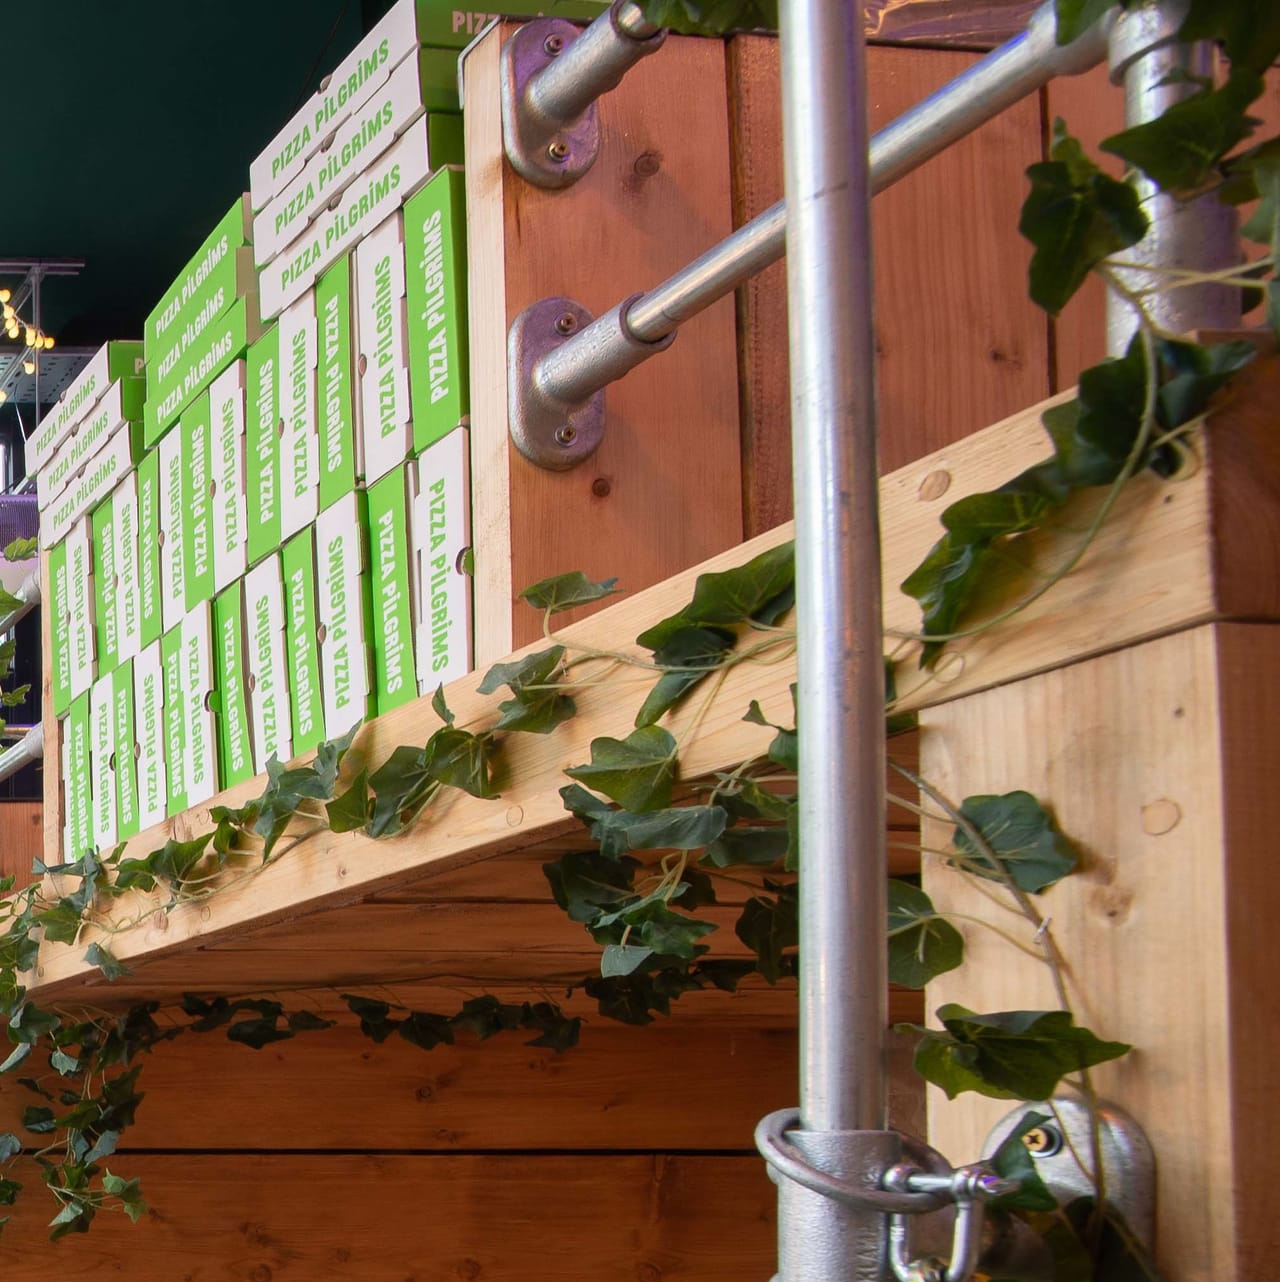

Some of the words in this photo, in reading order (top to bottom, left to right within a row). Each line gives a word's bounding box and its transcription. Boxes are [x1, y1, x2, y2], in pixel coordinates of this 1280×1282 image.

[452, 10, 498, 35] PIZ
[272, 124, 311, 179] PIZZA
[275, 182, 314, 236] PIZZA
[281, 240, 321, 291] PIZZA
[156, 296, 181, 339] PIZZA
[325, 294, 339, 364] PIZZA
[158, 346, 181, 384] PIZZA
[428, 327, 449, 405] PIZZA
[157, 384, 183, 425] PIZZA
[381, 367, 396, 438] PIZZA
[36, 425, 57, 456] PIZZA
[294, 432, 308, 498] PIZZA
[48, 458, 69, 490] PIZZA
[260, 460, 273, 525] PIZZA
[53, 499, 75, 529] PIZZA
[143, 479, 151, 532] PIZZA
[223, 493, 238, 553] PIZZA
[429, 478, 446, 552] PIZZA
[172, 543, 183, 599] PIZZA
[194, 519, 207, 577] PIZZA
[378, 509, 394, 582] PIZZA
[125, 586, 135, 638] PIZZA
[291, 568, 306, 632] PIZZA
[77, 623, 86, 672] PIZZA
[106, 603, 116, 655] PIZZA
[224, 616, 235, 674] PIZZA
[58, 642, 68, 690] PIZZA
[167, 651, 178, 706] PIZZA
[188, 636, 200, 692] PIZZA
[333, 643, 350, 710] PIZZA
[98, 703, 108, 751] PIZZA
[117, 688, 127, 740] PIZZA
[262, 692, 278, 754] PIZZA
[74, 723, 84, 772] PIZZA
[147, 760, 157, 813] PIZZA
